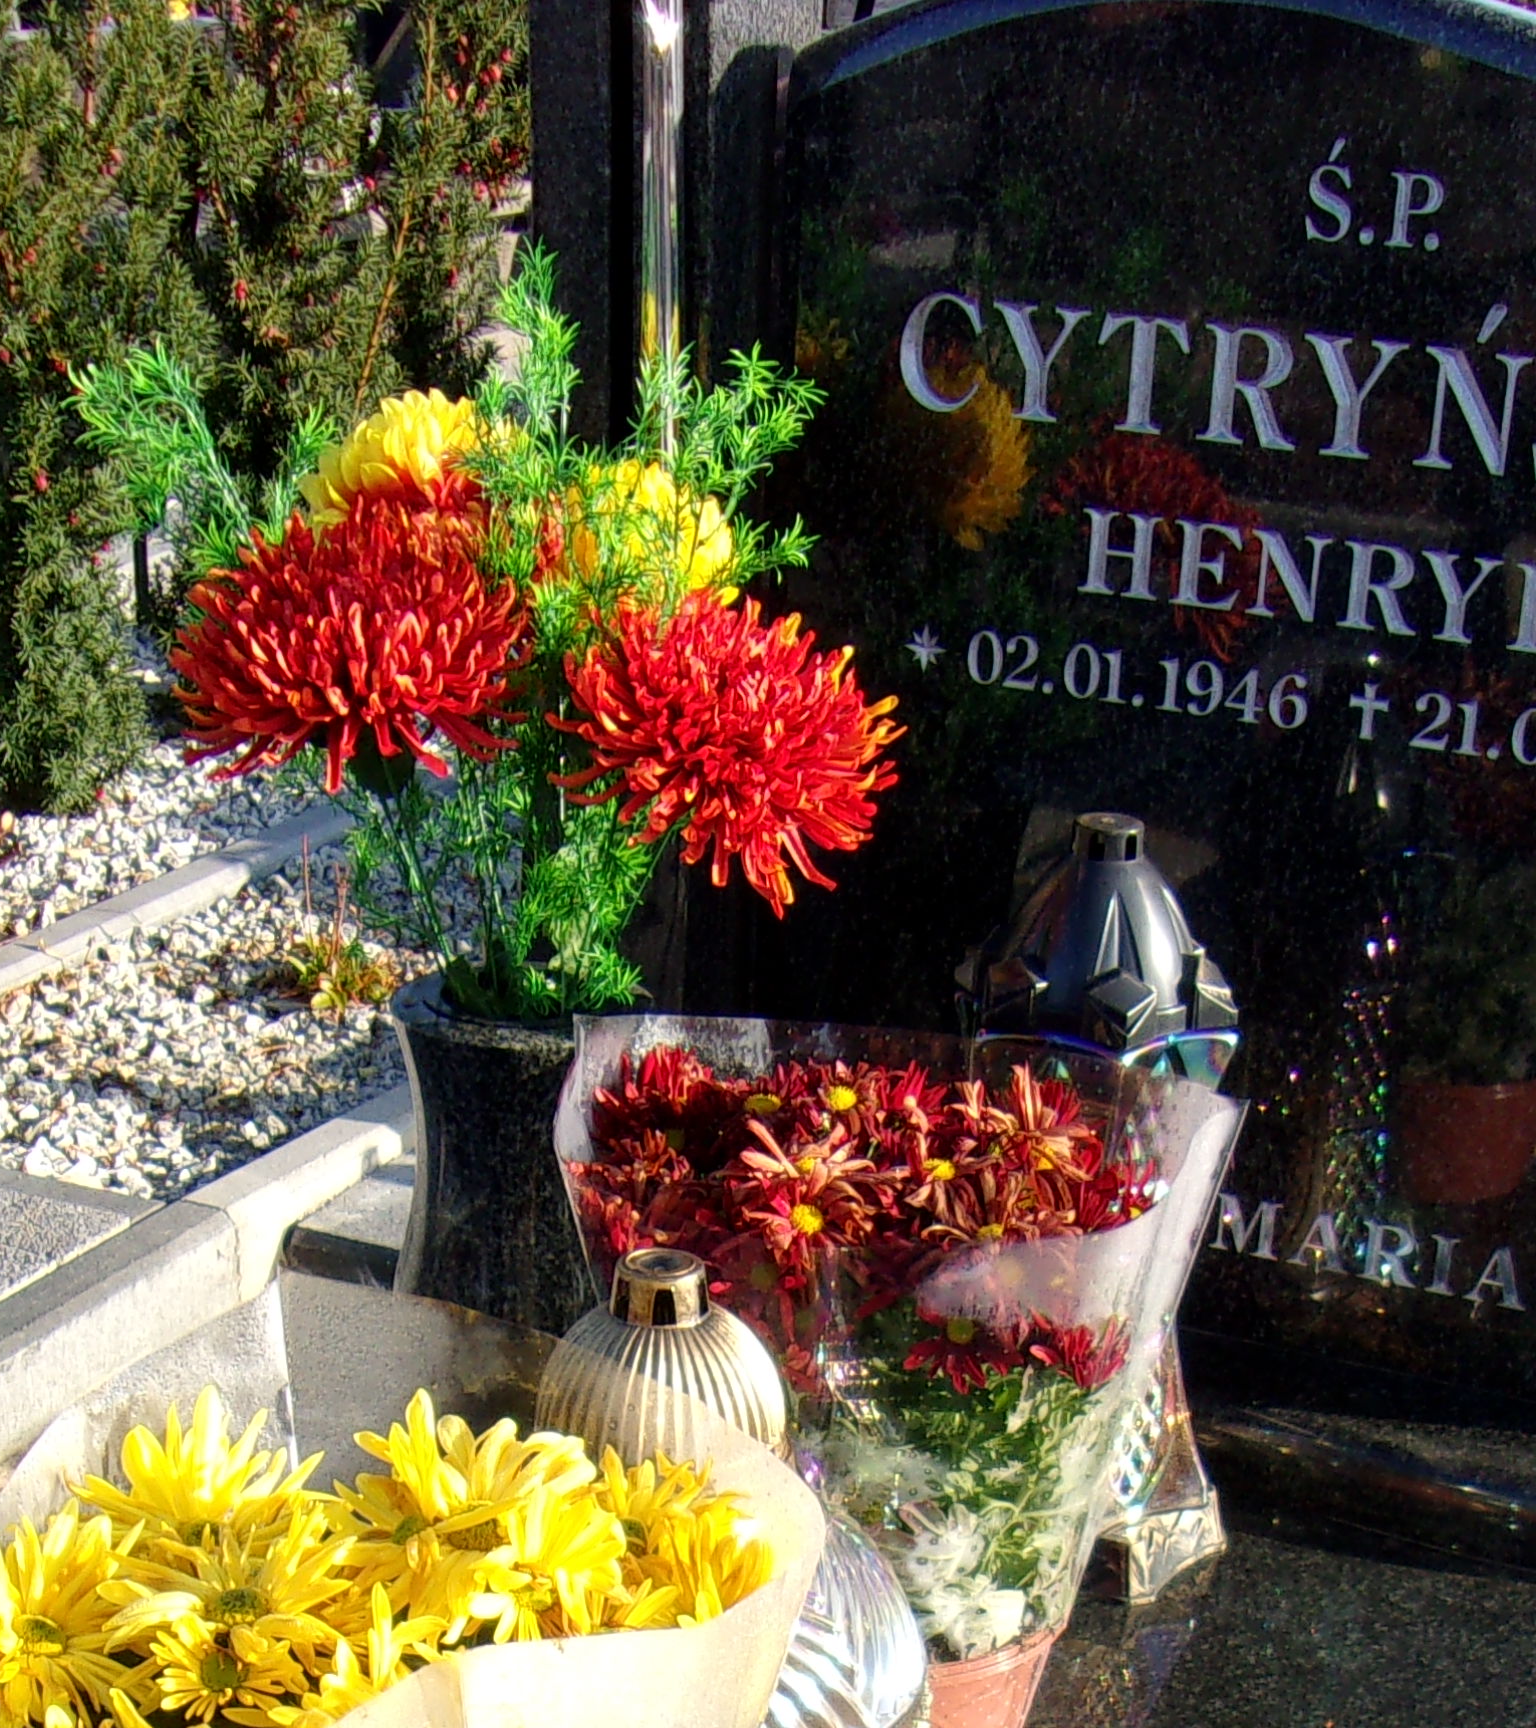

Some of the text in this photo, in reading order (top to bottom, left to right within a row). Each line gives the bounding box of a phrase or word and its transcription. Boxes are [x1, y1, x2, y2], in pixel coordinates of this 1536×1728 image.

[1305, 137, 1444, 251] Ś.P.
[967, 630, 1309, 729] 02.01.1946
[1208, 1192, 1526, 1312] MARIA
